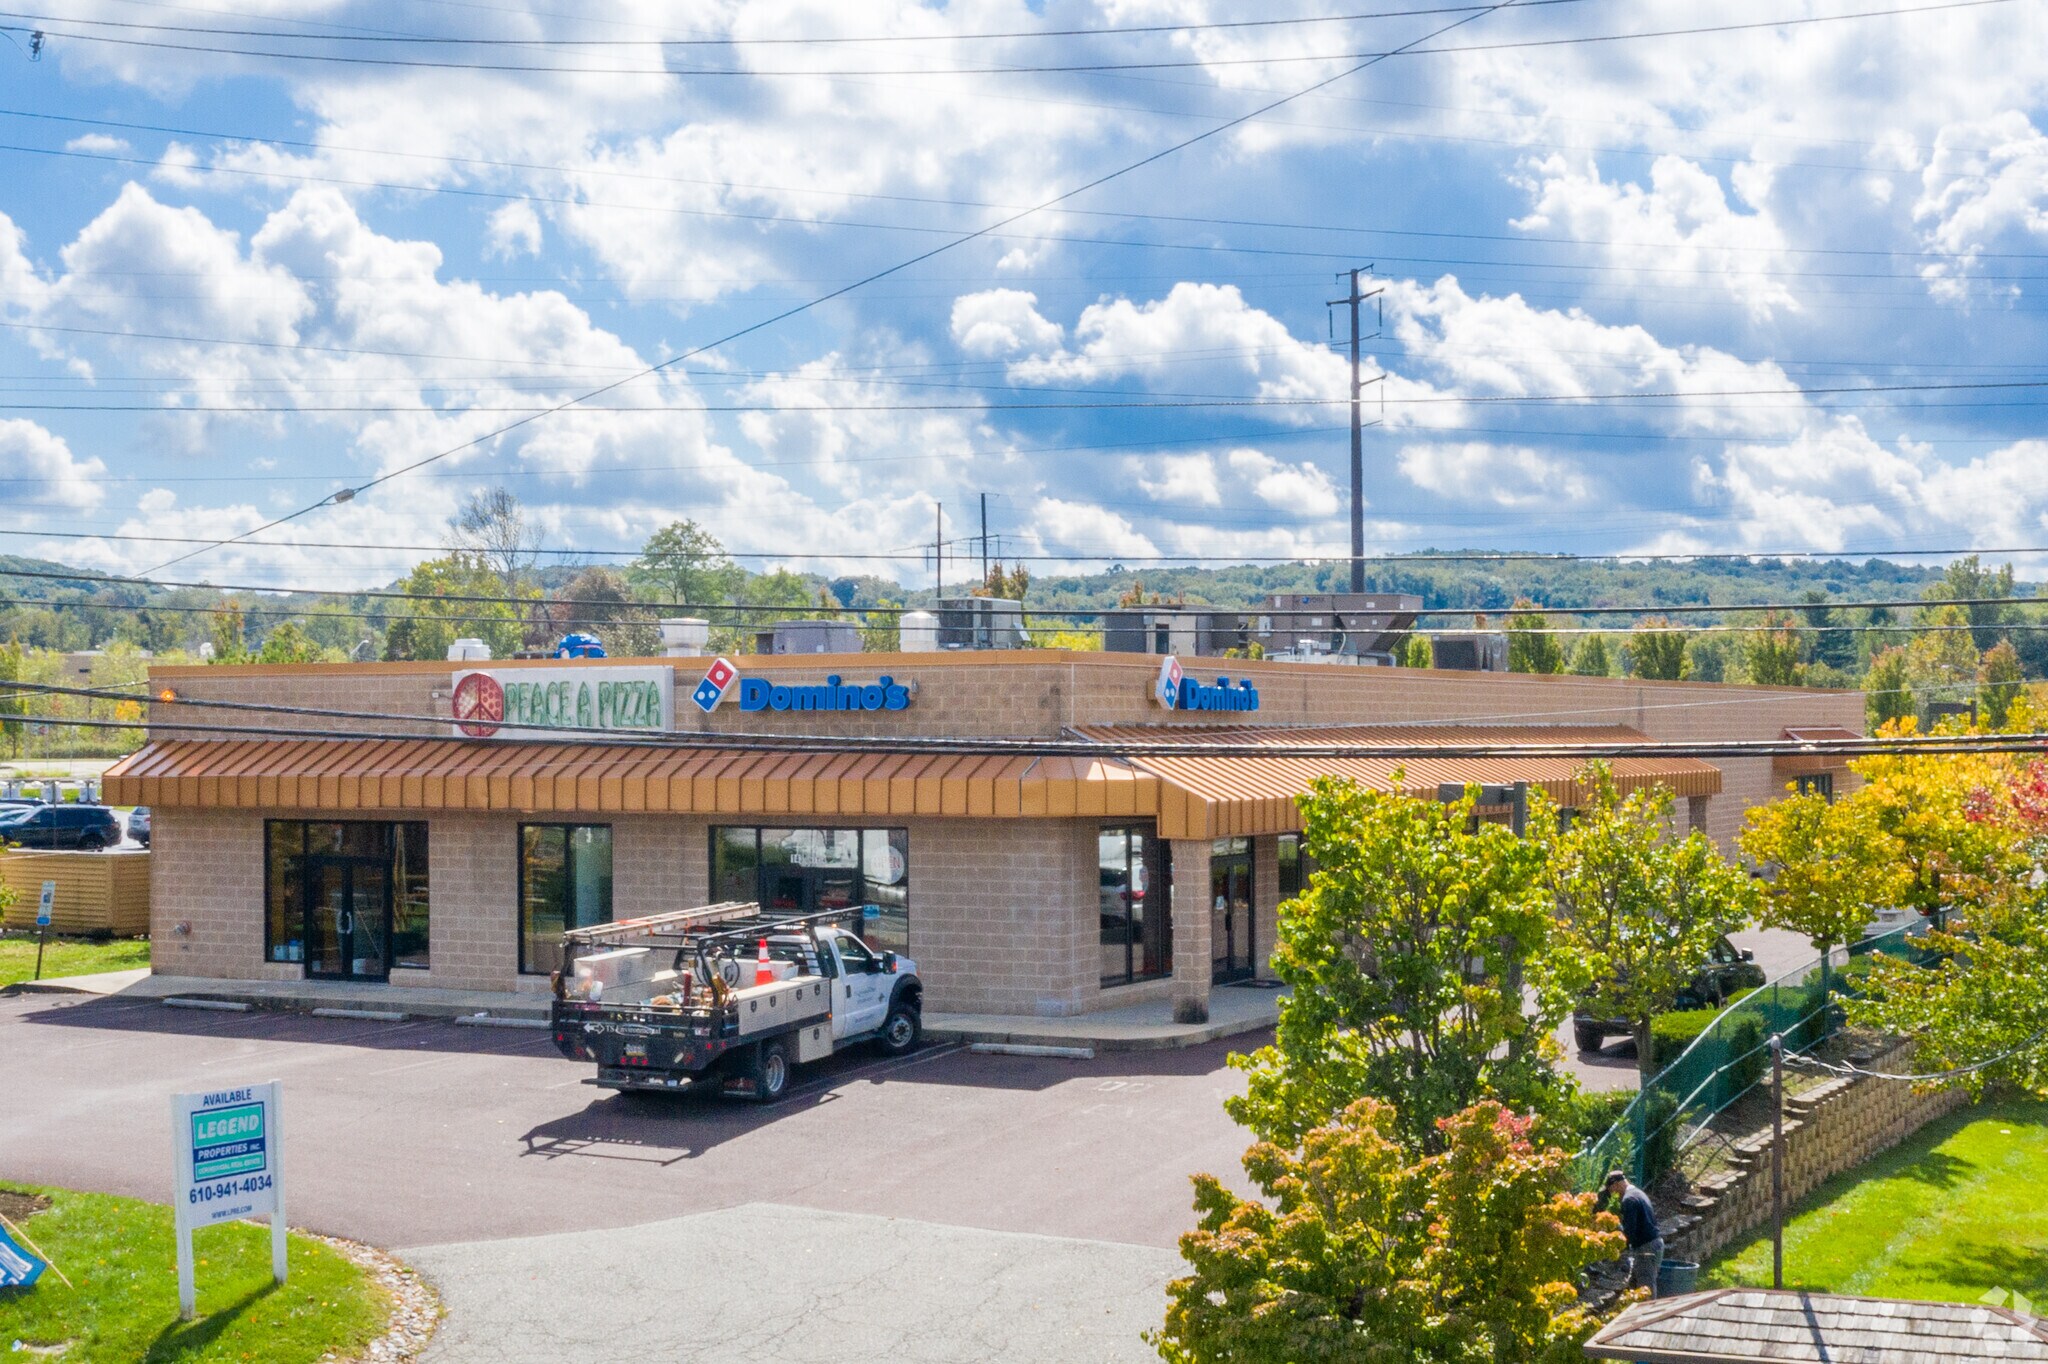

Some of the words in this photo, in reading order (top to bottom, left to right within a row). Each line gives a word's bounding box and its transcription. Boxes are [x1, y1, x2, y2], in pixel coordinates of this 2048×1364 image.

[504, 680, 572, 726] PEACE
[576, 680, 592, 726] A
[598, 680, 661, 727] PIZZA
[740, 674, 910, 711] Domino's
[1179, 676, 1259, 711] Domino's
[203, 1089, 252, 1106] AVAILABLE
[197, 1114, 259, 1139] LEGEND
[198, 1143, 248, 1160] PROPERTIES
[189, 1174, 272, 1204] 610-941-4034
